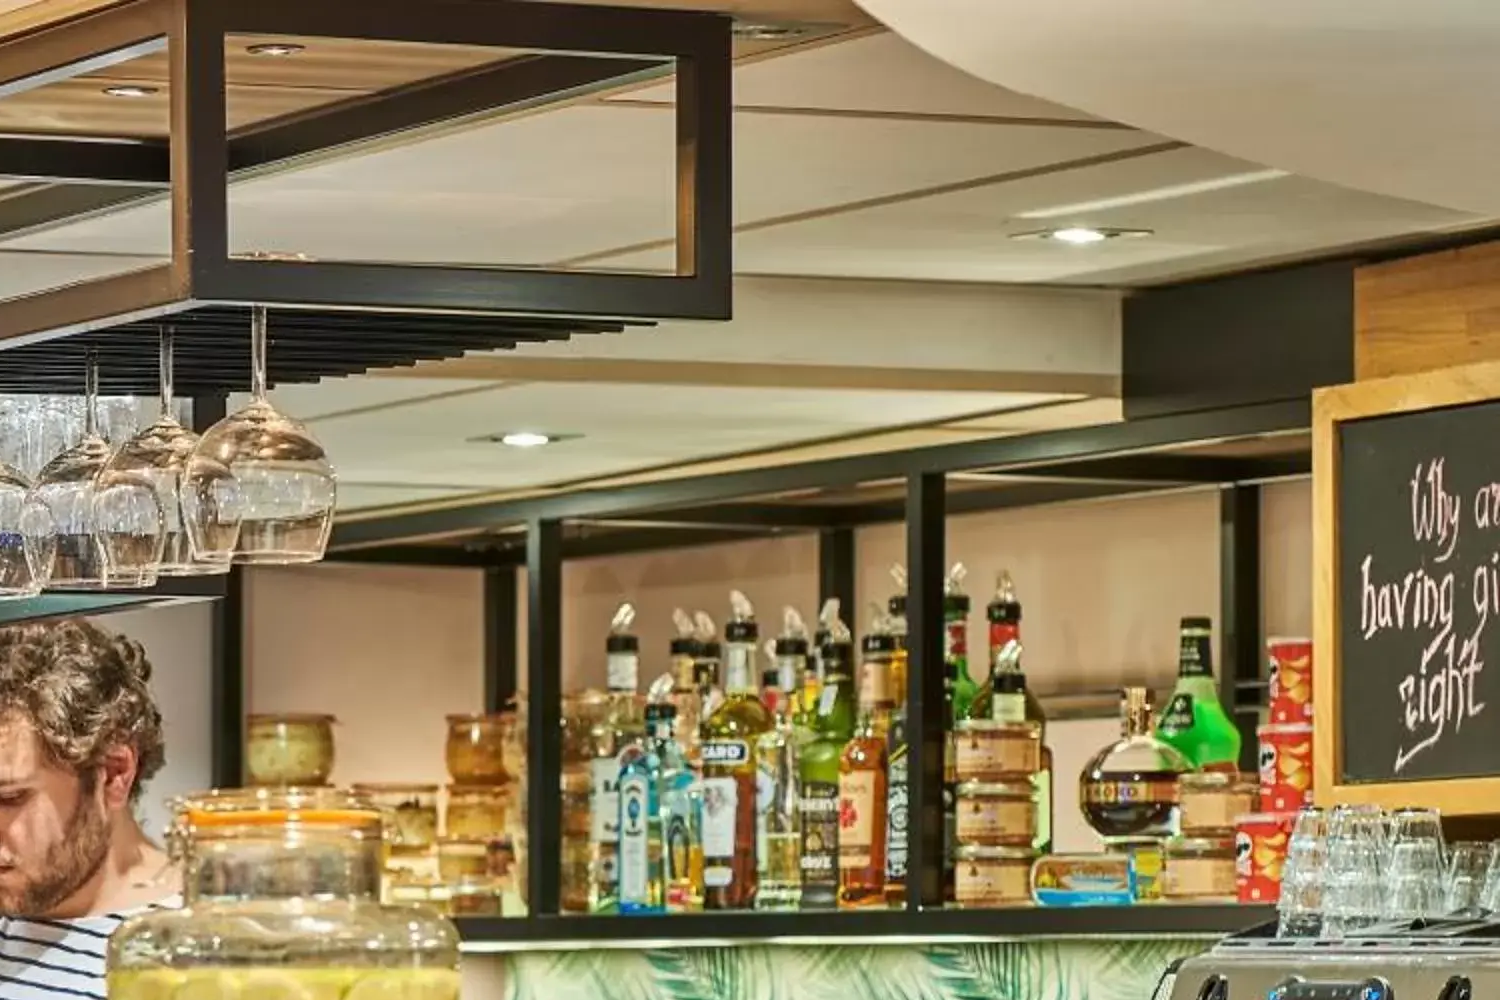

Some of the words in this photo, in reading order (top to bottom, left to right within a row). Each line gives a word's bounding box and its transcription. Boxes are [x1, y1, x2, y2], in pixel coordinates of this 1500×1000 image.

[1410, 457, 1460, 562] Why
[1361, 554, 1455, 672] having
[1394, 632, 1486, 774] right
